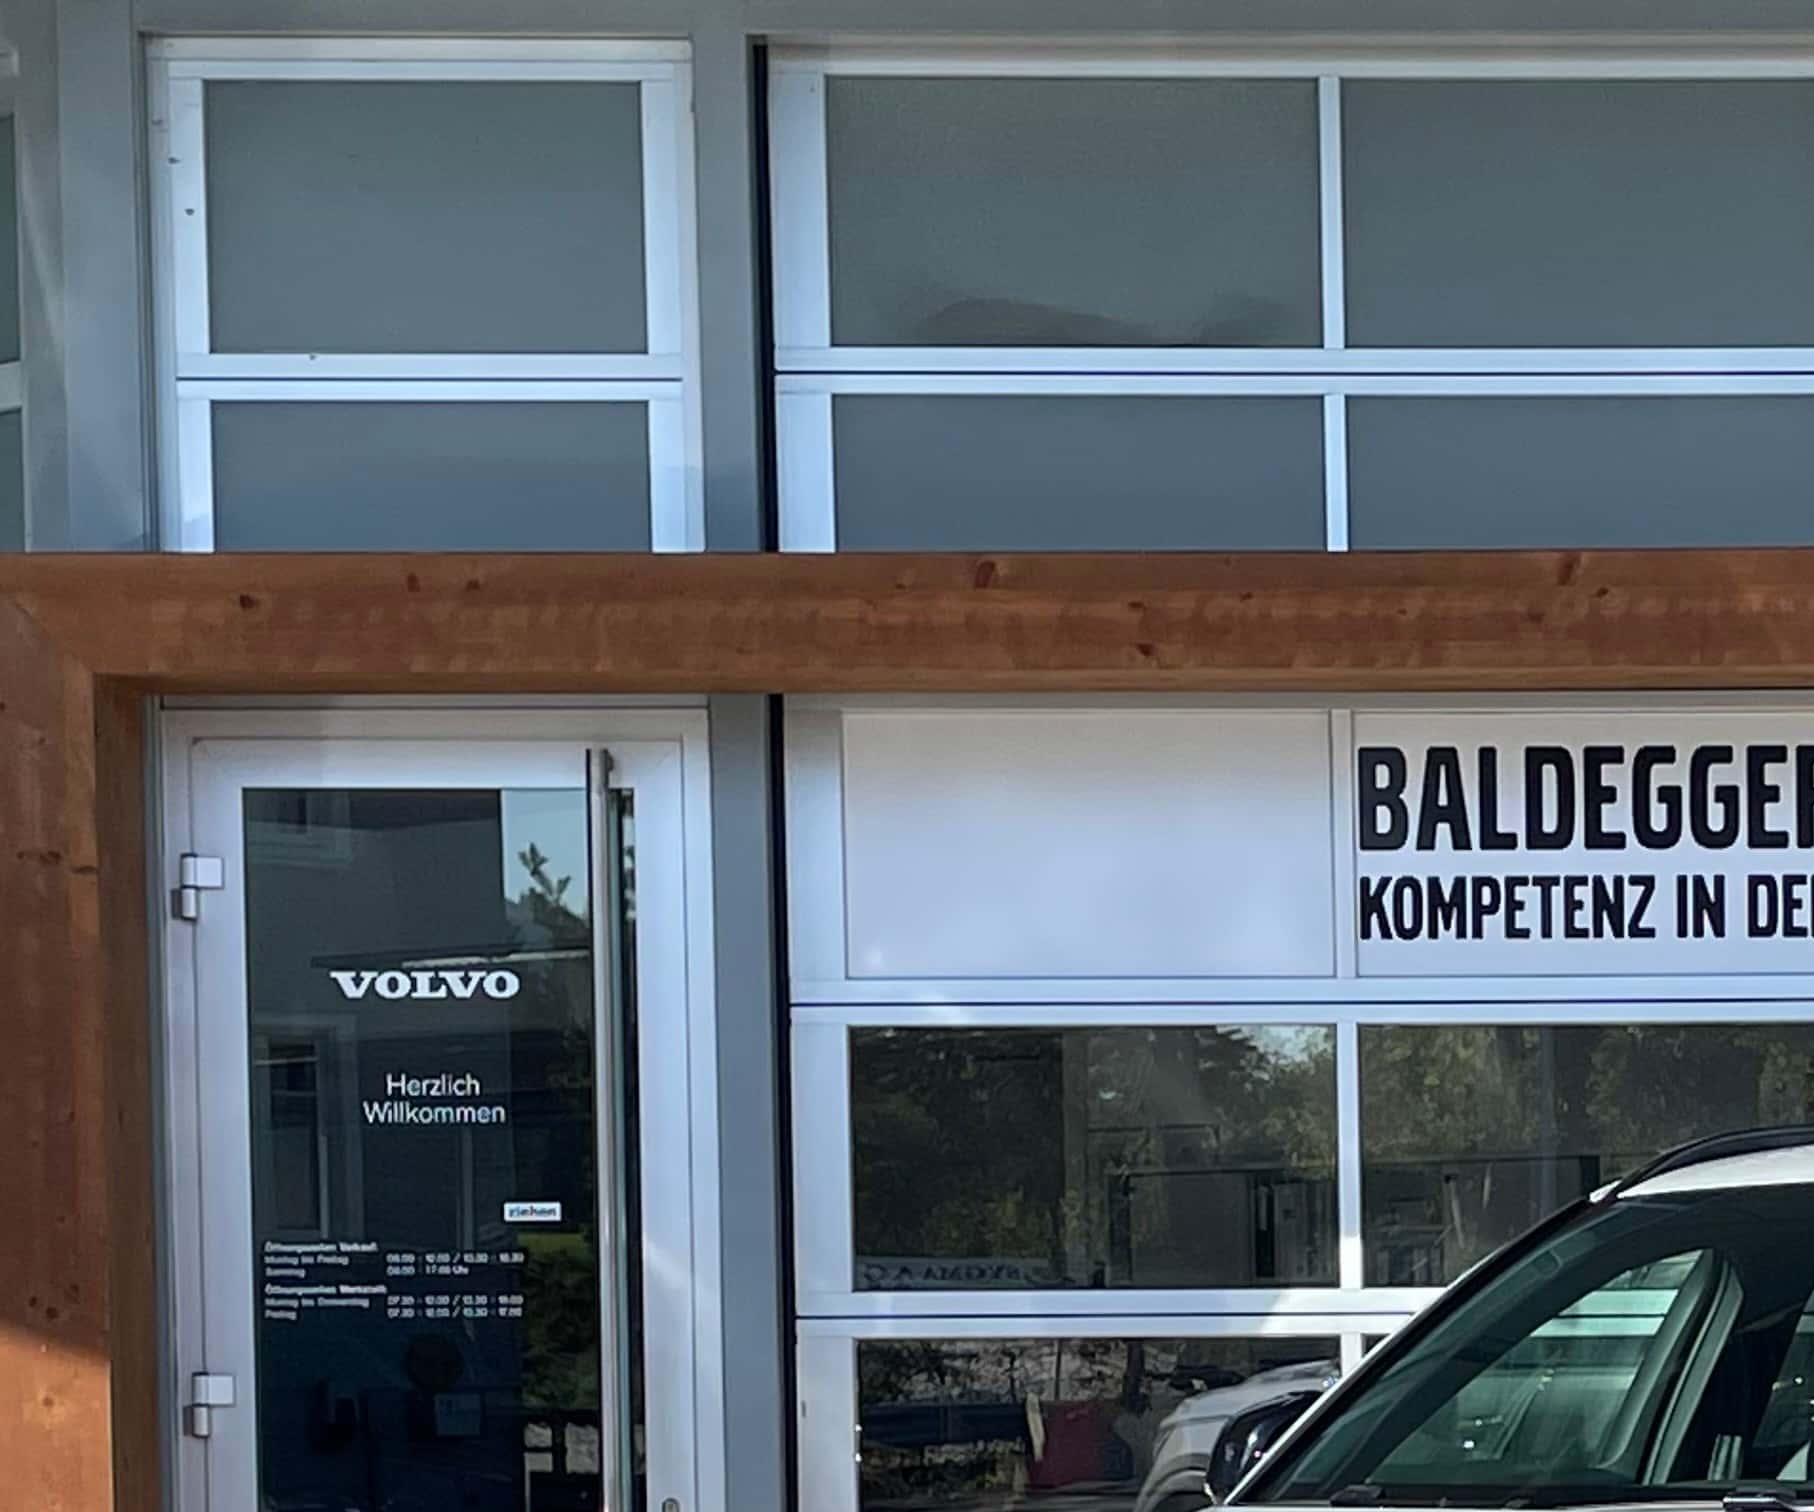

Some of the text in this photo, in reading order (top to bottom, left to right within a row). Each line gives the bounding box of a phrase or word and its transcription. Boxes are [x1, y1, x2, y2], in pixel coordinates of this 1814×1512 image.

[1360, 874, 1657, 941] KOMPETENZ
[1675, 874, 1727, 939] IN
[329, 970, 521, 999] VOLVO
[386, 1073, 481, 1097] Herzlich
[362, 1101, 506, 1124] Willkommen
